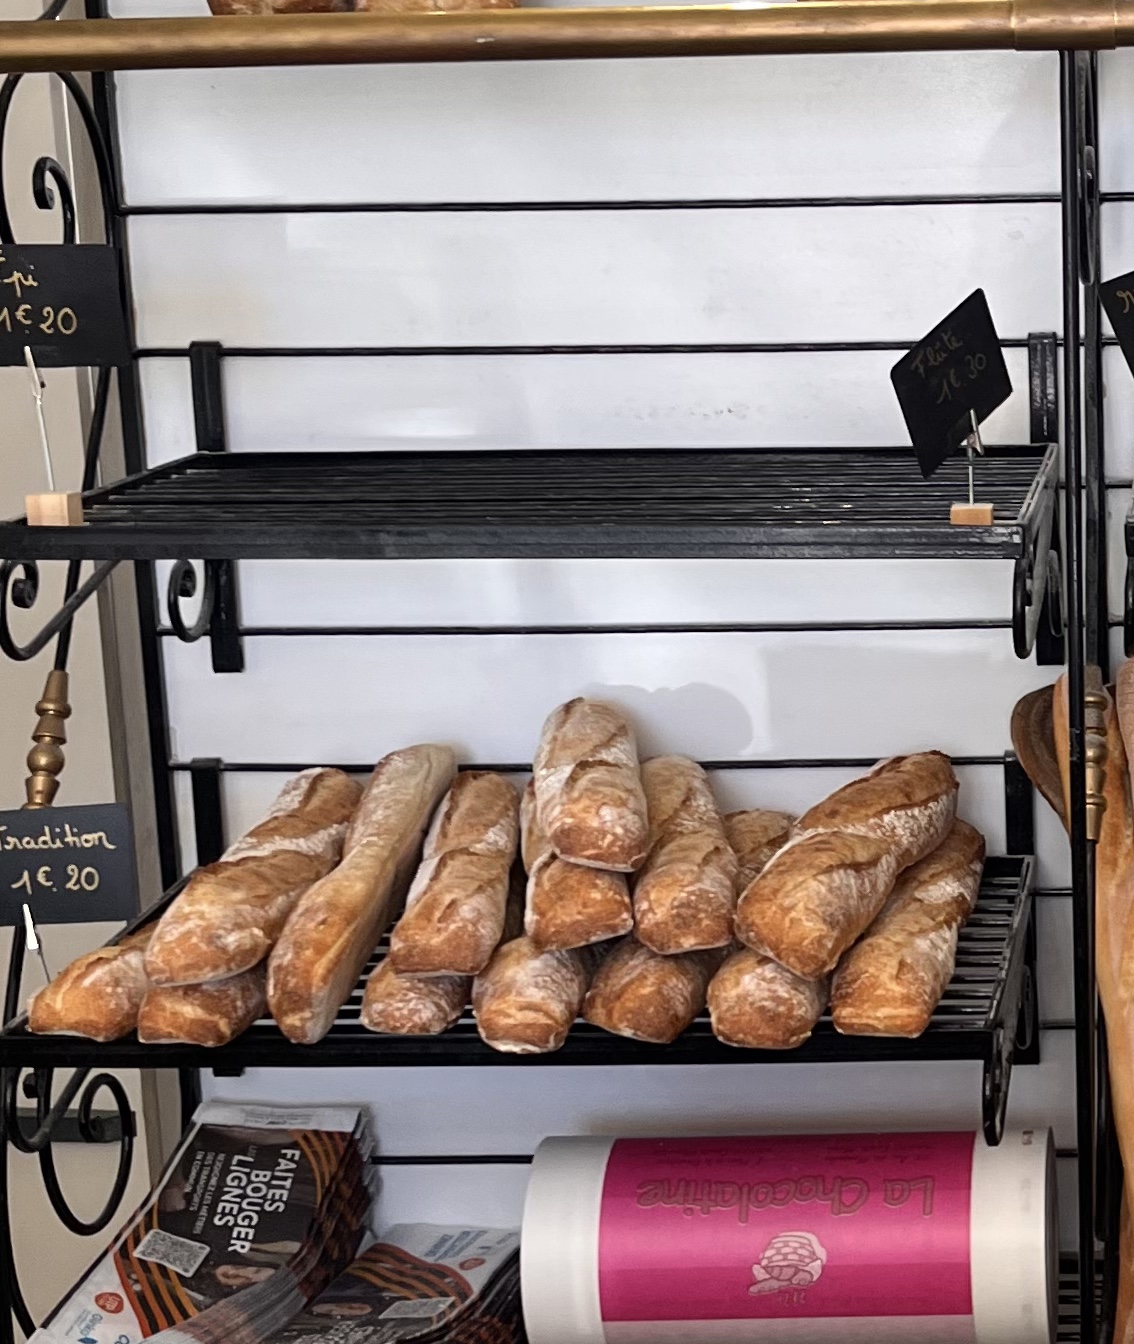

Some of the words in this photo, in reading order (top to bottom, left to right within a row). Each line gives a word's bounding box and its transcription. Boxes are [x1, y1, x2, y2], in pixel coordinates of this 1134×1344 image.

[213, 1154, 254, 1226] LIGNES
[227, 1170, 272, 1253] BOUGER
[264, 1149, 301, 1212] FAITES
[636, 1176, 868, 1223] Chocolatine
[884, 1176, 936, 1216] La
